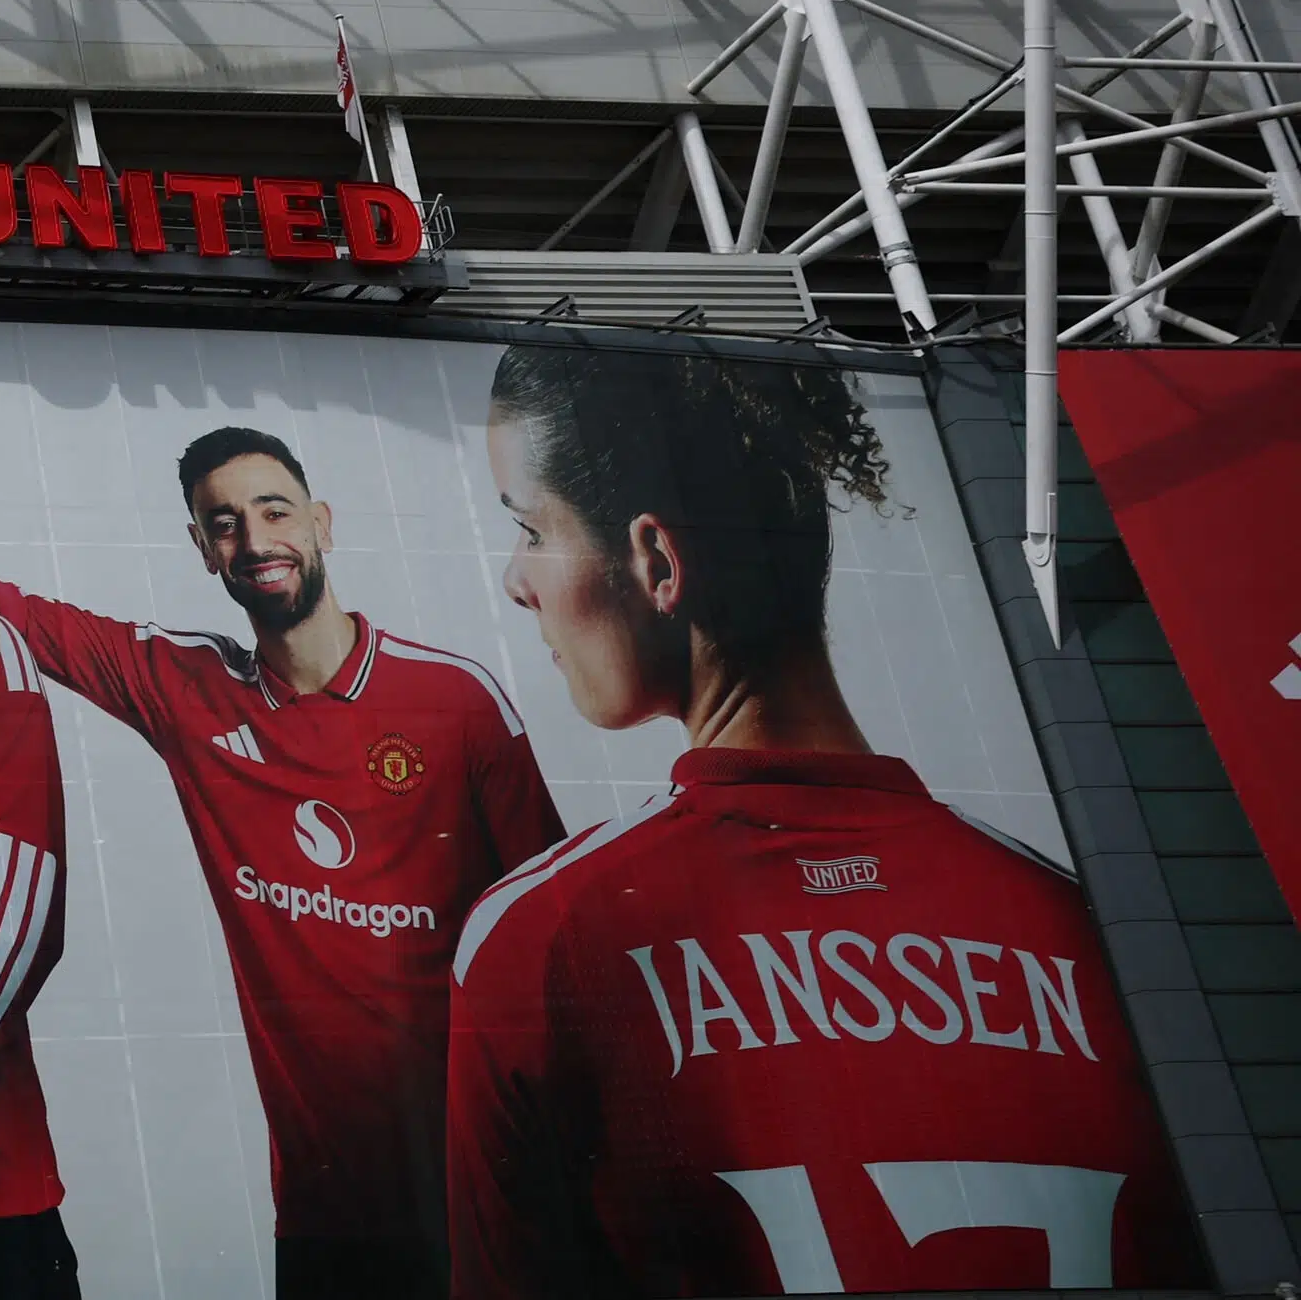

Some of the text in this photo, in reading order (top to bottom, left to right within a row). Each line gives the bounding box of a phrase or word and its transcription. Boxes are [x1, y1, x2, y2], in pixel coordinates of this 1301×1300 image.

[234, 865, 436, 938] Snapdragon
[802, 862, 878, 888] UNITED
[626, 929, 1099, 1078] JANSSEN
